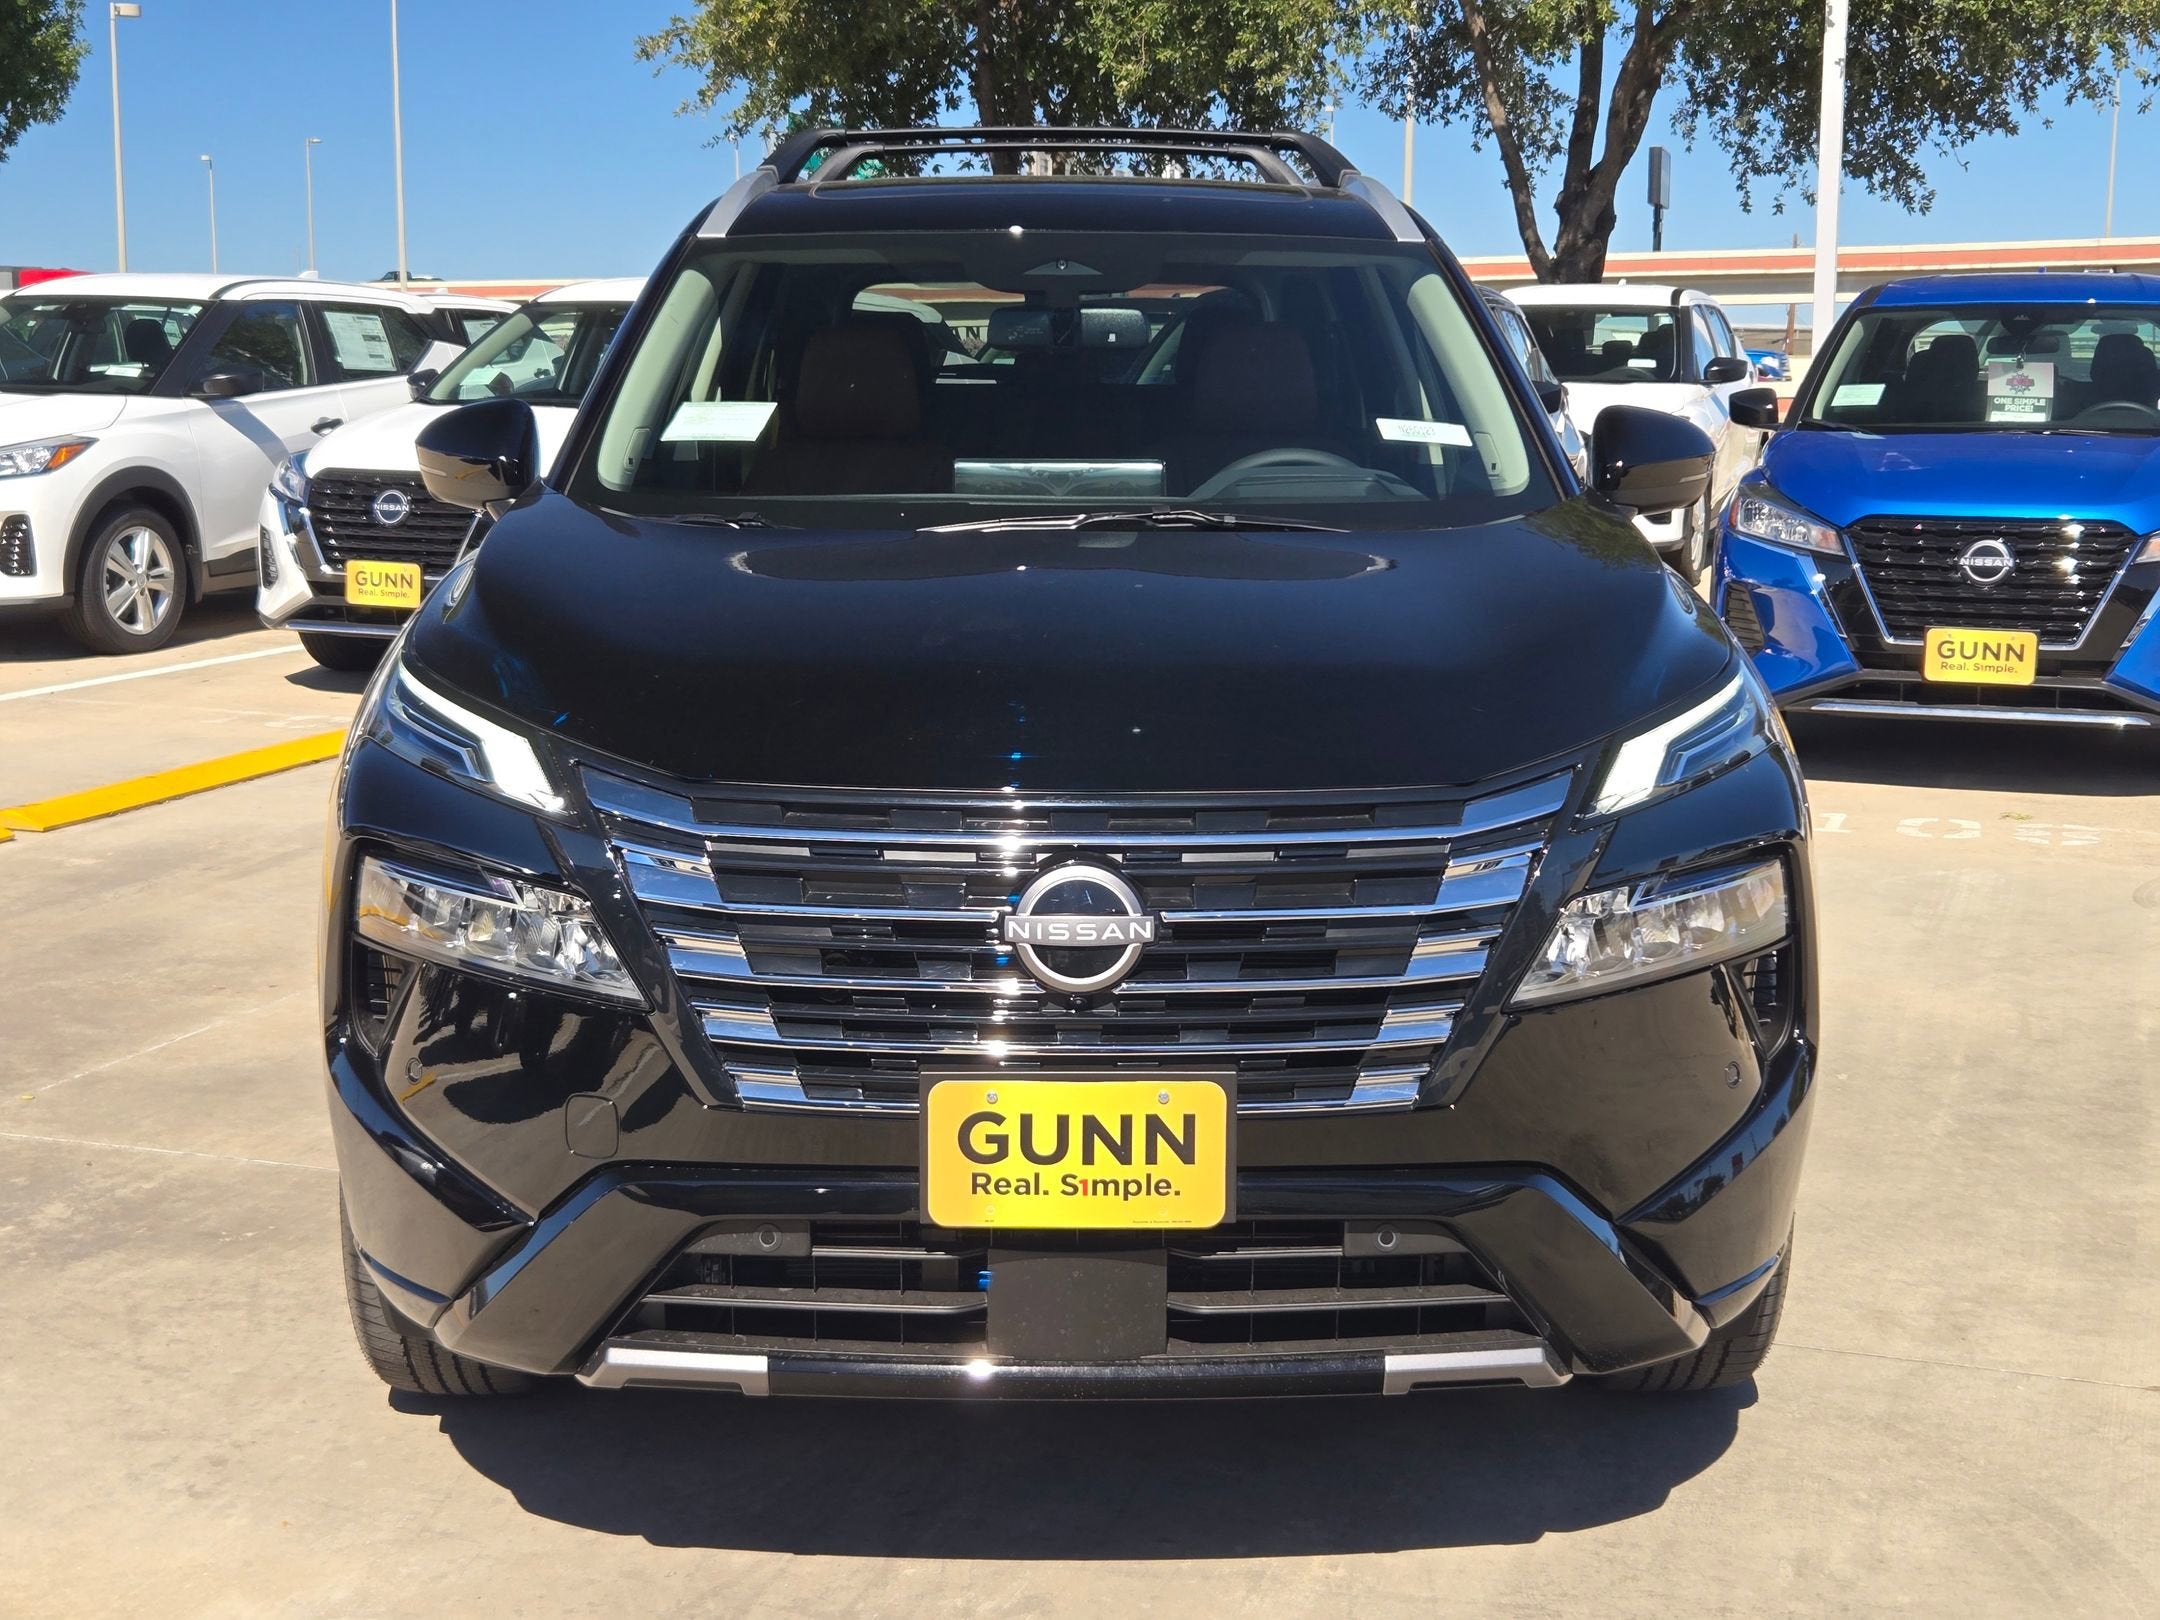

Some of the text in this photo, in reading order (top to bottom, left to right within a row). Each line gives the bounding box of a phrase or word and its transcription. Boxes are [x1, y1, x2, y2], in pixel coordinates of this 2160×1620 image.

[1994, 397, 2046, 406] ONE SIMPLE
[2004, 404, 2034, 412] PRICE!
[374, 503, 409, 511] NISSAN
[1959, 557, 2014, 567] NISSAN
[355, 570, 413, 589] GUNN
[358, 588, 378, 596] Real.
[1937, 640, 2025, 662] GUNN
[1940, 661, 1970, 671] Real.
[1008, 920, 1152, 941] NISSAN
[957, 1110, 1196, 1166] GUNN
[971, 1172, 1050, 1196] Real.
